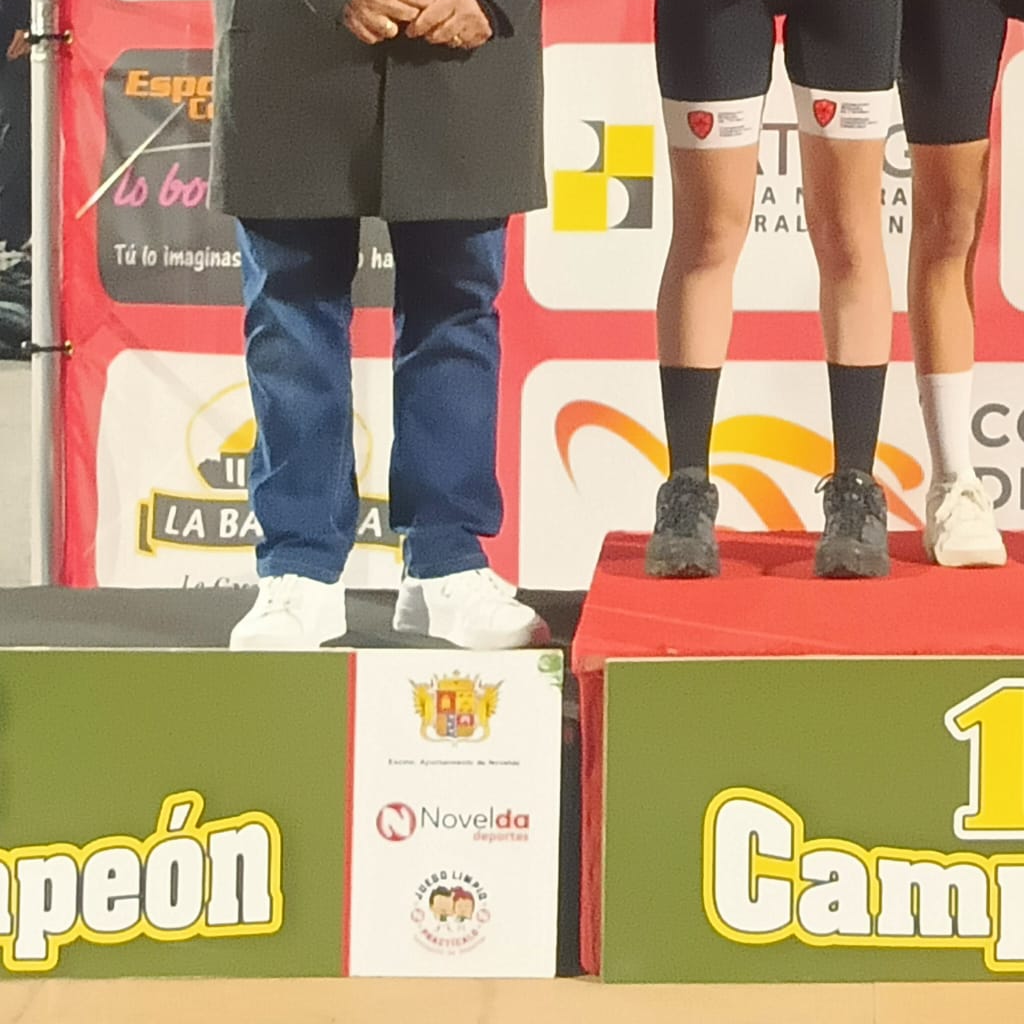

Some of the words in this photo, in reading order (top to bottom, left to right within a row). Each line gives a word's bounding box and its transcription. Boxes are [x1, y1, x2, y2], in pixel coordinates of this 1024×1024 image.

[163, 244, 242, 272] imaginas
[164, 505, 206, 539] LA
[420, 806, 529, 829] Novelda
